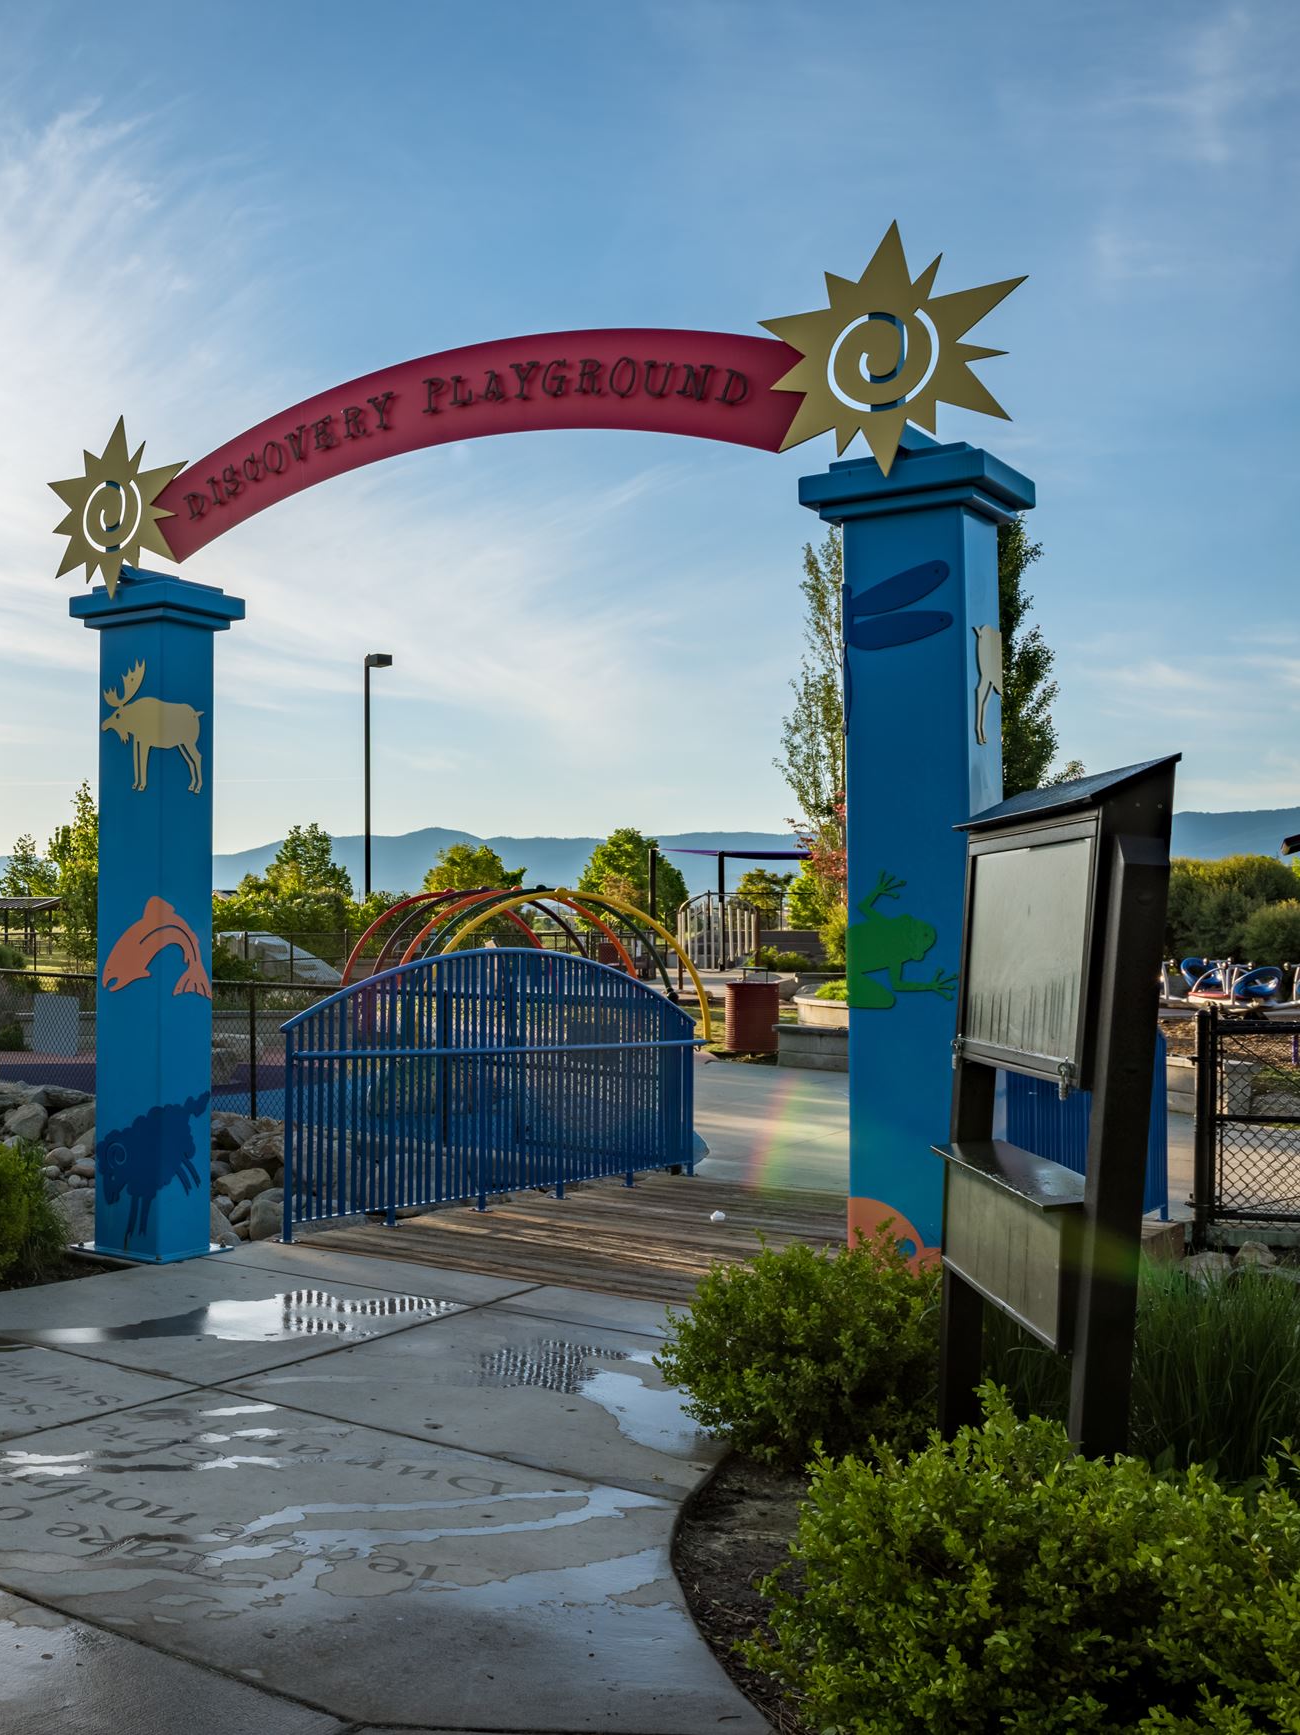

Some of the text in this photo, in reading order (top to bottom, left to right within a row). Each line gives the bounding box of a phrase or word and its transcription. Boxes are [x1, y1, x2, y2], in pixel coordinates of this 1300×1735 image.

[182, 356, 750, 521] DISCOVERY PLAYGROUND
[62, 1420, 228, 1462] Chie
